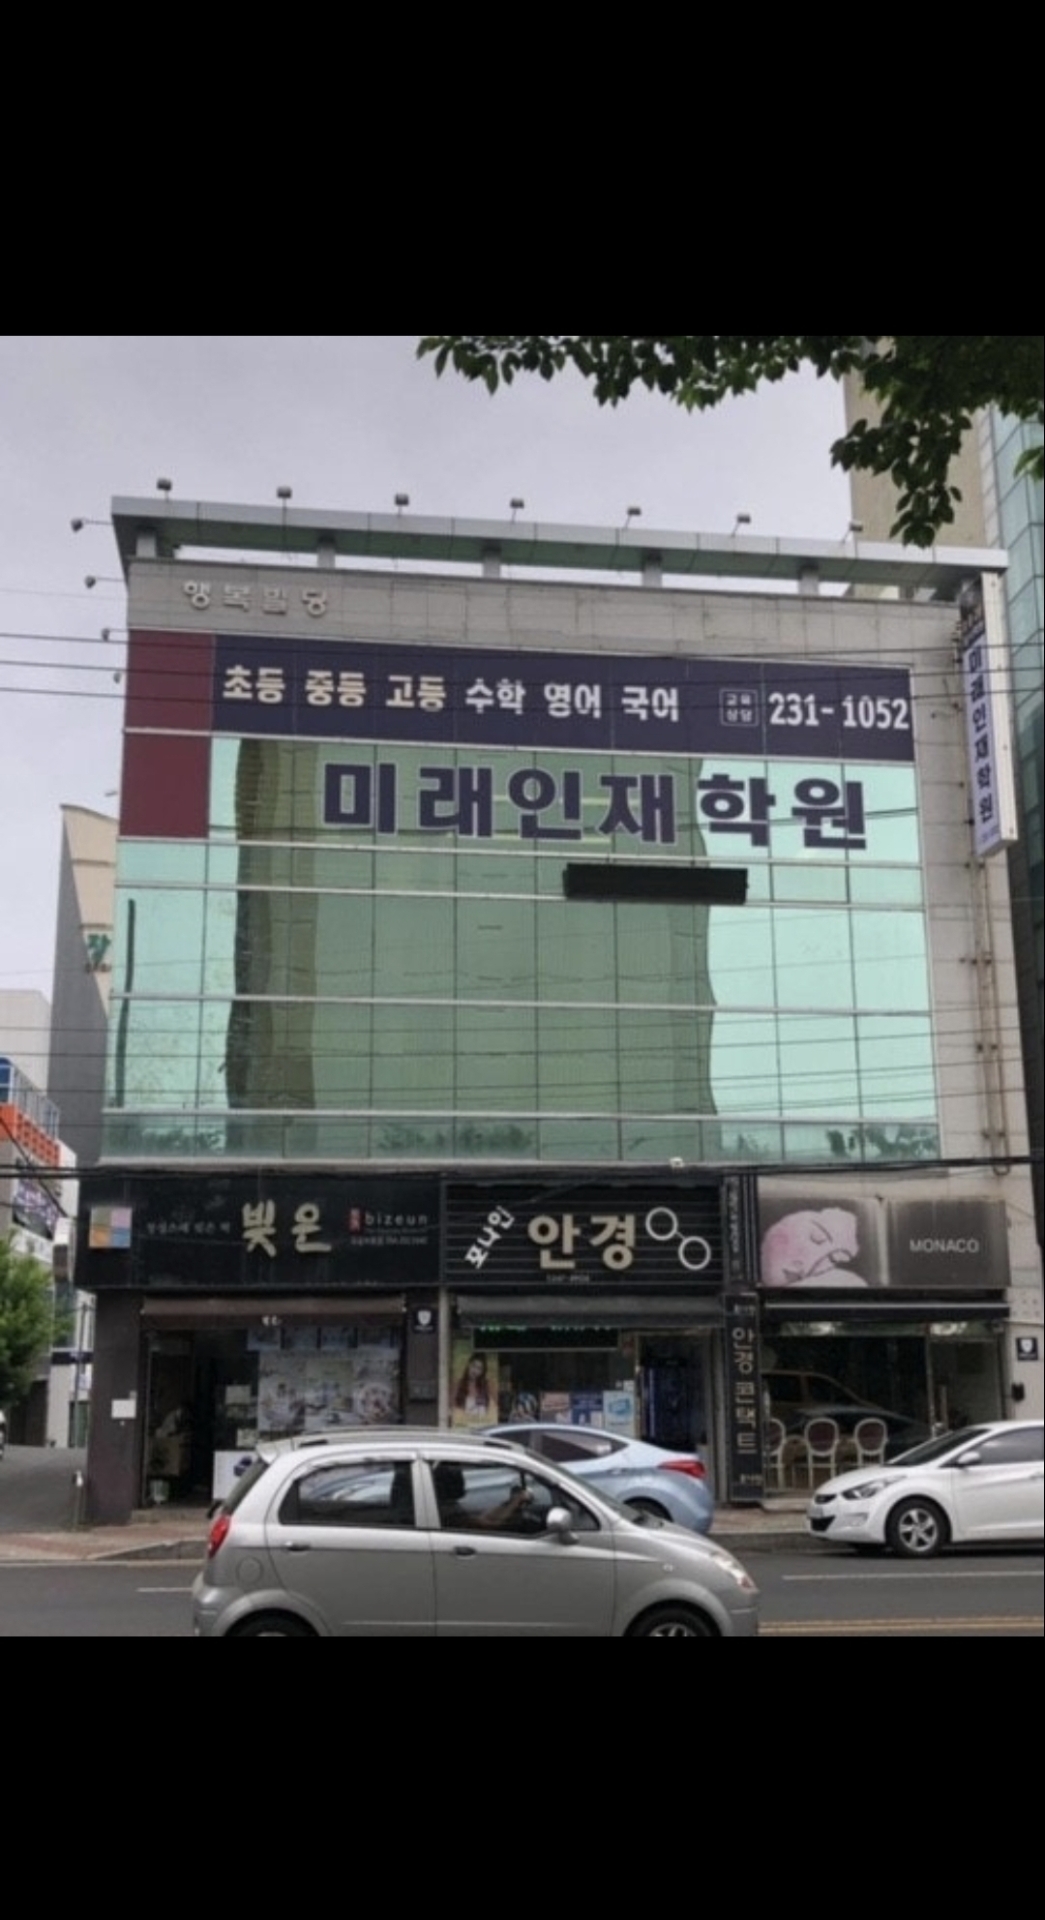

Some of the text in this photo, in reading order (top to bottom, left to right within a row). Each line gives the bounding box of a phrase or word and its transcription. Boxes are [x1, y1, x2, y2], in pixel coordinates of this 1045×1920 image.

[184, 580, 328, 618] 행복빌딩
[222, 666, 679, 722] 초등 중등 고등 수학 영어 국어
[322, 761, 868, 850] 미래인재학원
[242, 1199, 333, 1258] 빚은
[364, 1211, 428, 1227] bizeun
[527, 1213, 636, 1271] 안경
[909, 1239, 979, 1254] MONACO
[731, 1327, 754, 1375] 안경
